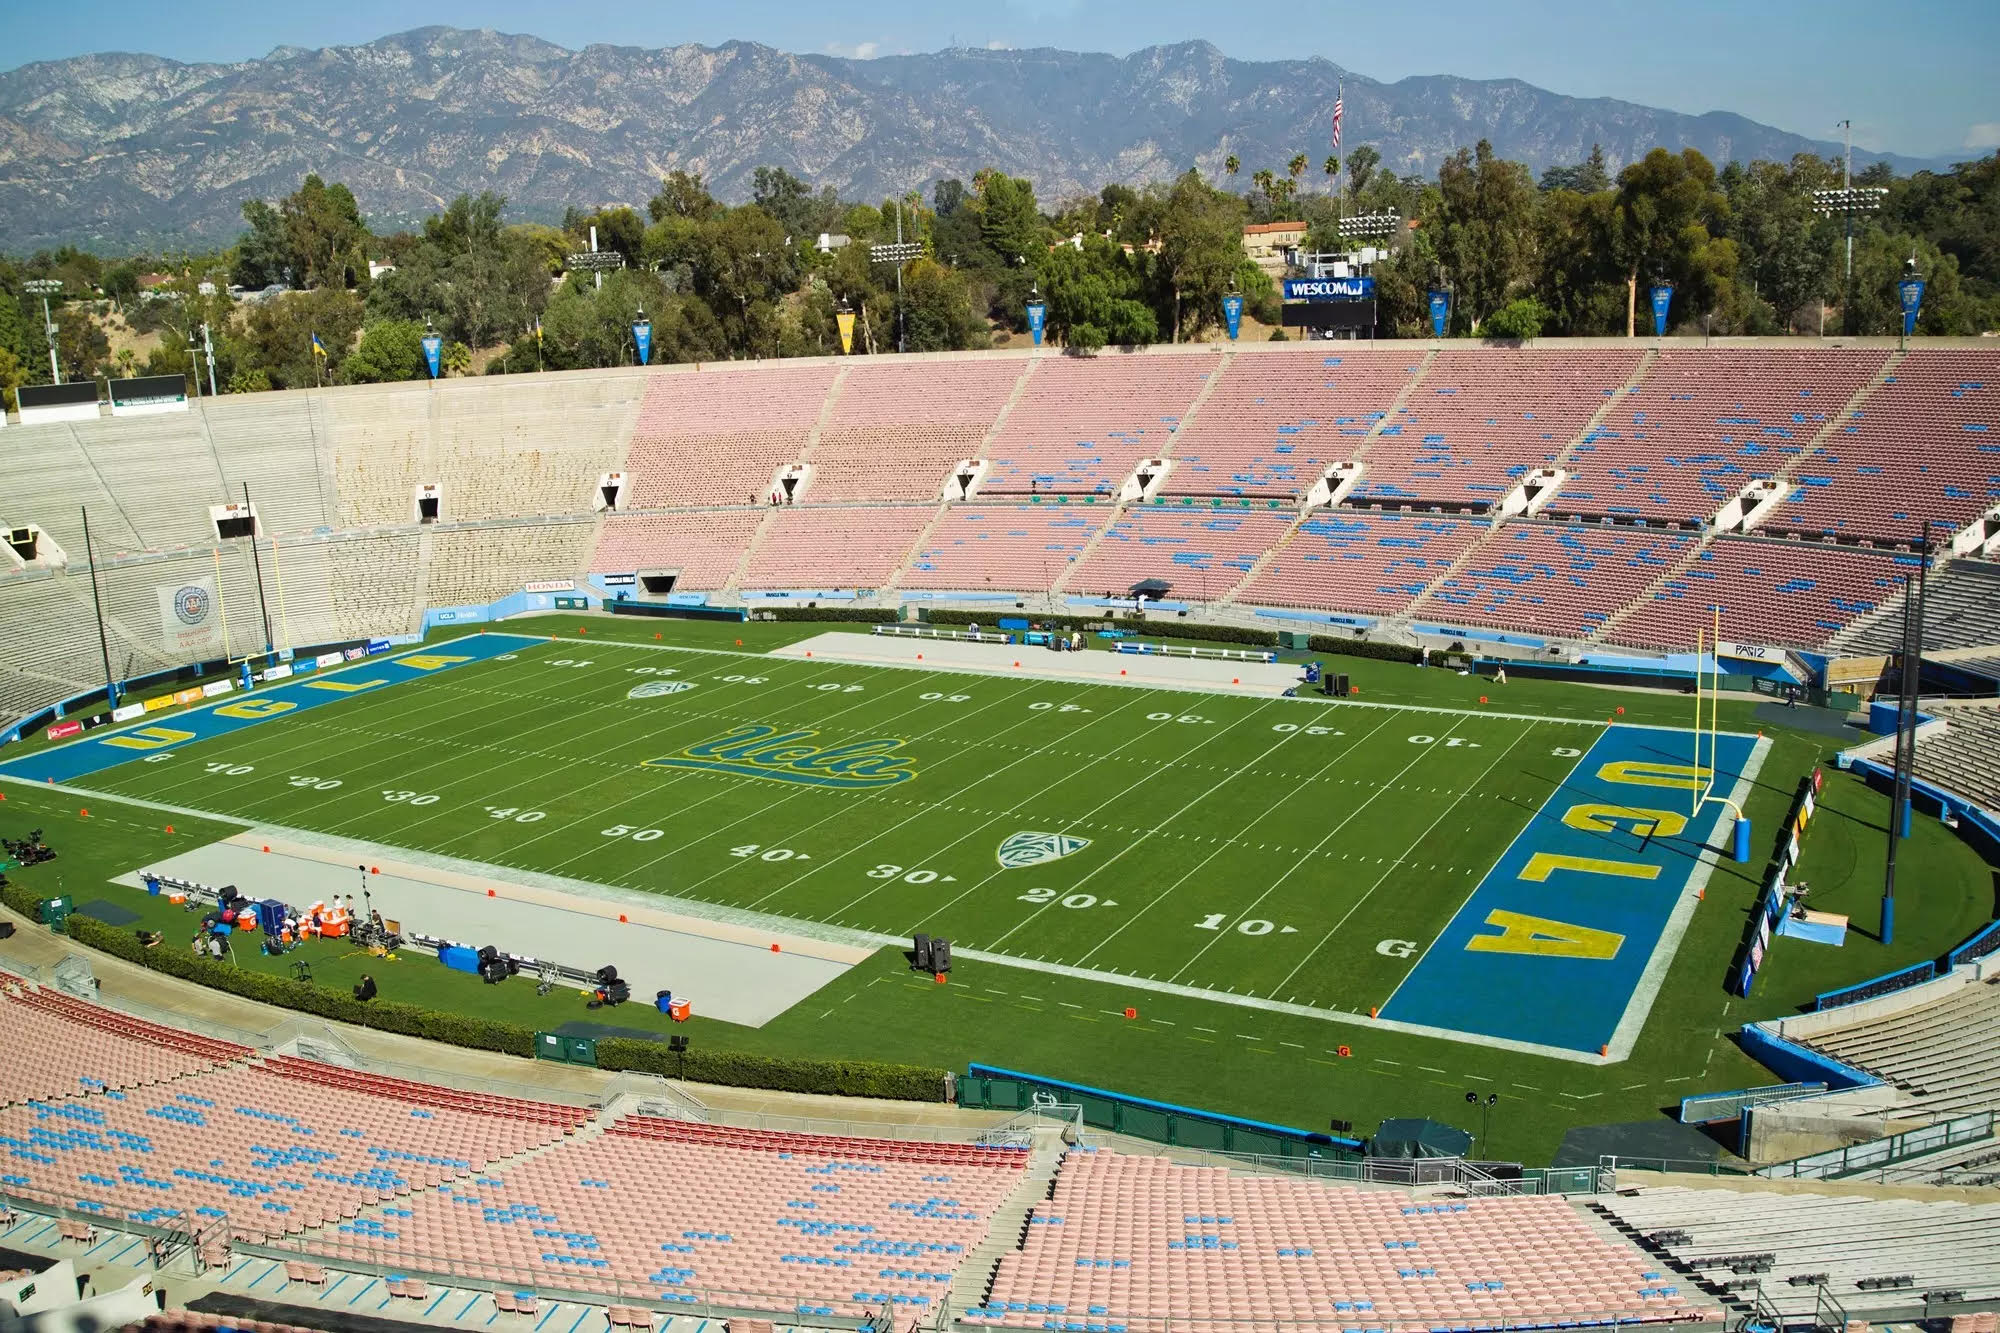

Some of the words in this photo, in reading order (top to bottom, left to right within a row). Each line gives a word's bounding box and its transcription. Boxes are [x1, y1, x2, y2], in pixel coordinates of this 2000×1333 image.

[1292, 281, 1348, 296] WESCOM
[527, 582, 573, 591] HONDA
[176, 626, 211, 638] Insurance
[553, 659, 595, 668] 10
[634, 667, 678, 676] 20
[722, 675, 770, 684] 30
[817, 683, 864, 693] 40
[98, 655, 477, 750] UCLA
[919, 692, 971, 702] 50
[1028, 702, 1081, 712] 40
[1146, 713, 1204, 723] 30
[1271, 723, 1334, 735] 20
[1407, 735, 1468, 747] 10
[144, 753, 174, 763] G
[1550, 747, 1581, 757] G
[207, 764, 254, 775] 10
[293, 777, 343, 790] 20
[387, 791, 441, 805] 30
[490, 807, 546, 823] 40
[601, 824, 665, 841] 50
[730, 844, 794, 862] 40
[1464, 760, 1714, 960] UCLA
[866, 864, 938, 884] 30
[1016, 888, 1097, 909] 20
[1193, 913, 1275, 936] 10
[1375, 939, 1417, 958] G
